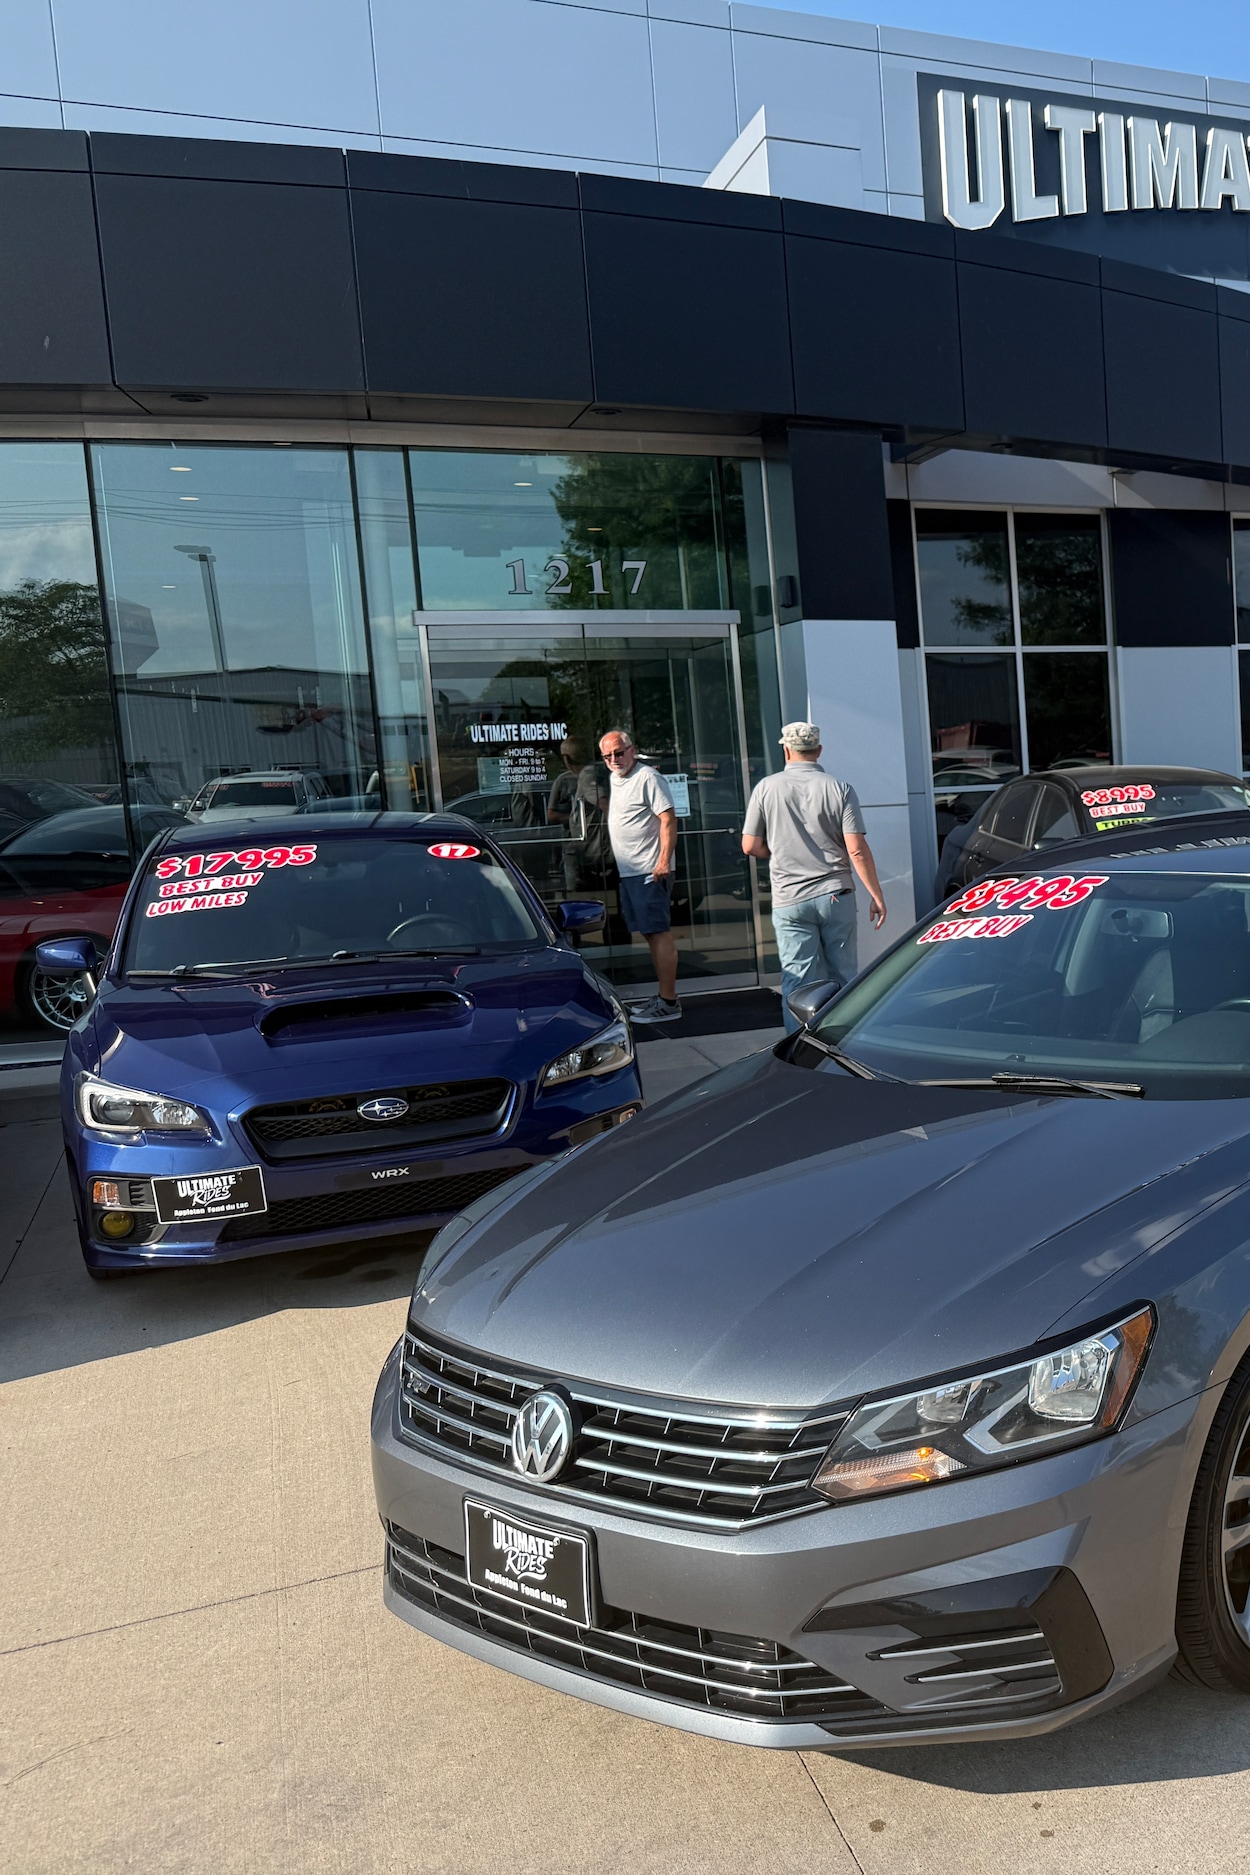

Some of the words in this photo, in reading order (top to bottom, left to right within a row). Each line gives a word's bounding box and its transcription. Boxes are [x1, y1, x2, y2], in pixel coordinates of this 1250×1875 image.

[506, 558, 647, 595] 1217
[470, 724, 519, 743] ULTIMATE
[520, 723, 549, 741] RIDES
[550, 722, 568, 740] INC
[509, 747, 535, 757] HOURS
[500, 766, 530, 774] SATURDAY
[500, 775, 523, 783] CLOSED
[524, 774, 547, 782] SUNDAY
[1081, 784, 1156, 806] $8995
[1090, 805, 1119, 817] BEST
[1123, 802, 1145, 813] BUY
[155, 845, 317, 879] $17995
[438, 844, 469, 857] 17
[160, 878, 215, 897] BEST
[220, 873, 263, 888] BUY
[943, 876, 1110, 914] $8495
[148, 898, 188, 916] LOW
[190, 892, 247, 909] MILES
[918, 917, 980, 943] BEST
[973, 914, 1033, 937] BUY
[371, 1166, 410, 1179] WRX
[176, 1174, 237, 1198] ULTIMATE
[174, 1208, 205, 1217] Appleton
[207, 1205, 225, 1213] Fond
[226, 1203, 235, 1211] du
[236, 1201, 249, 1209] Lac
[492, 1518, 555, 1559] ULTIMATE
[484, 1568, 519, 1592] Appleton
[520, 1582, 541, 1600] Fond
[540, 1590, 552, 1604] du
[552, 1594, 568, 1609] Lac
